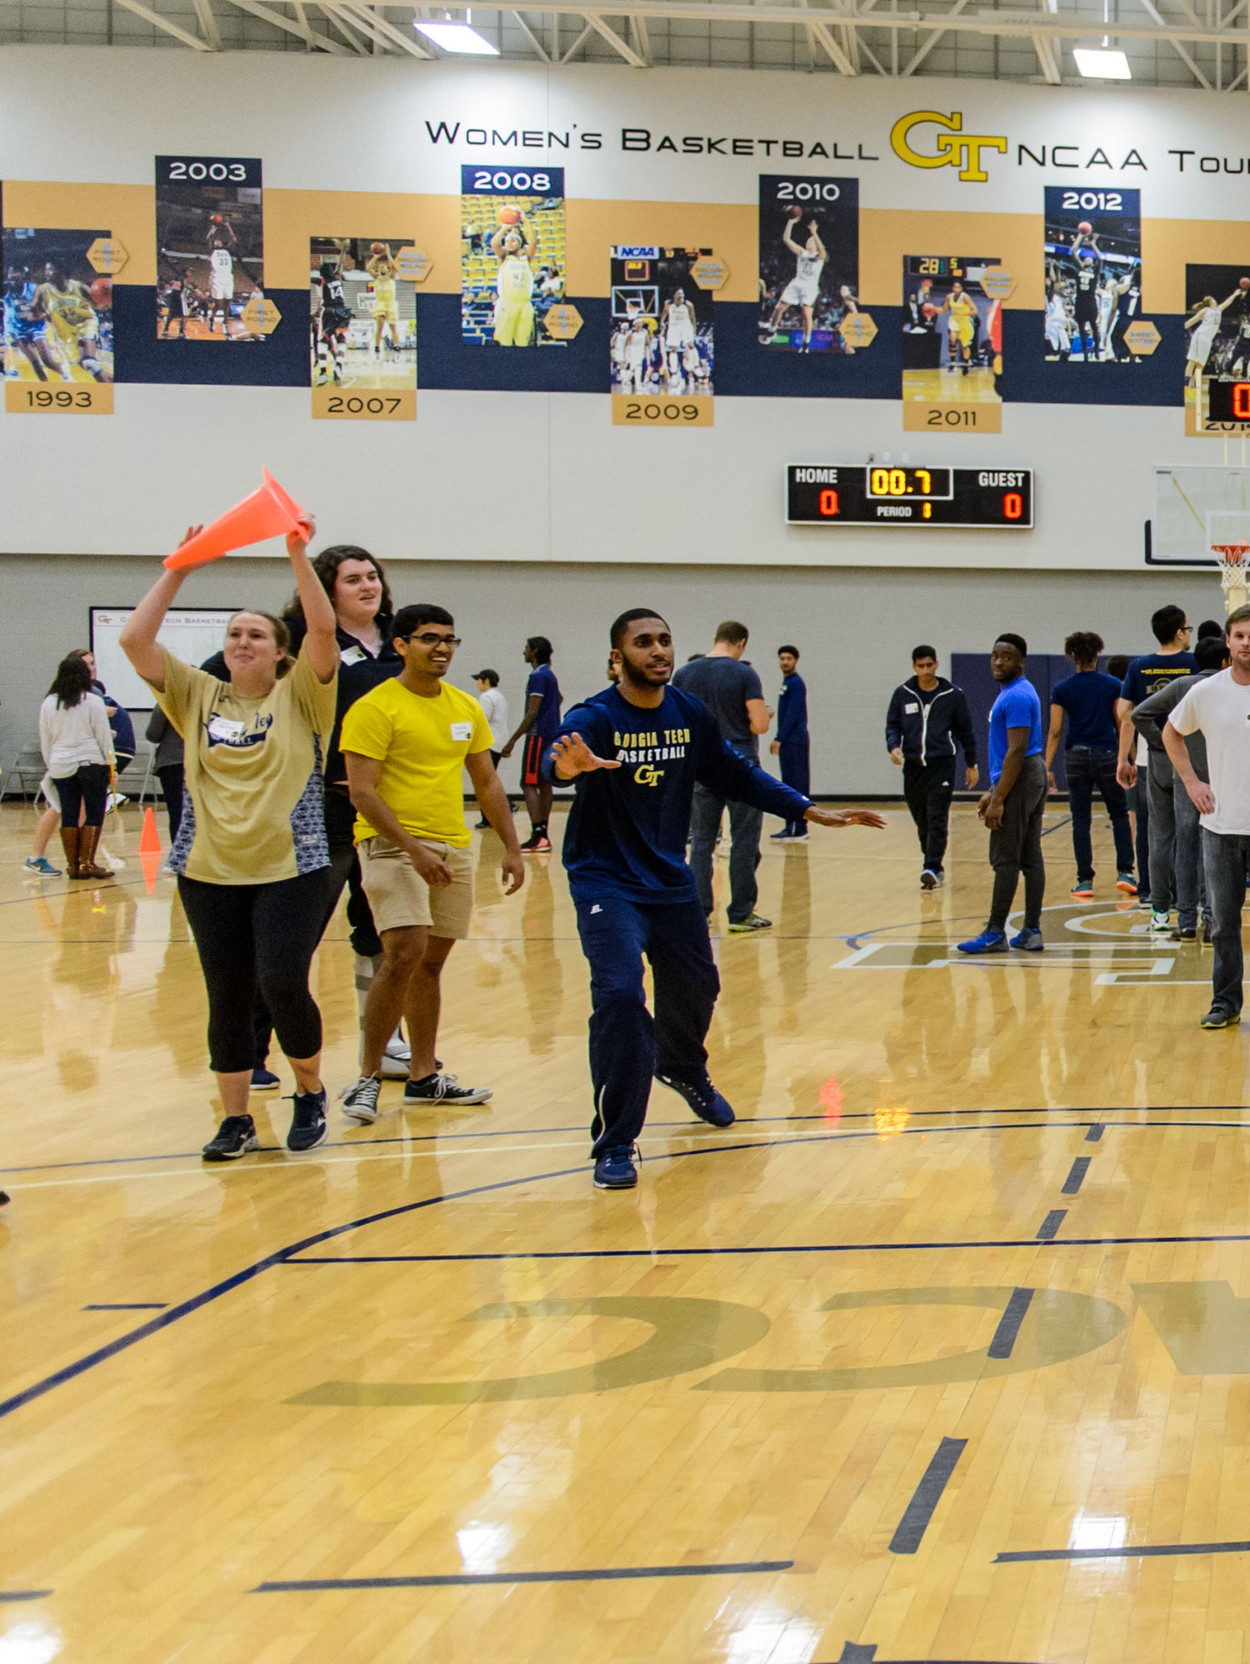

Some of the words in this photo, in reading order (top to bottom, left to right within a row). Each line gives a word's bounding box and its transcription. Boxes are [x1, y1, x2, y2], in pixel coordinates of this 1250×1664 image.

[425, 121, 602, 150] WOMEN'S
[621, 128, 879, 161] BASKETBALL
[890, 110, 1007, 182] GT
[1017, 144, 1148, 171] NCAA
[169, 162, 247, 181] 2003
[474, 171, 551, 190] 2008
[776, 182, 840, 201] 2010
[1062, 192, 1123, 211] 2012
[621, 247, 656, 257] NCAA
[27, 391, 92, 408] 1993
[328, 397, 402, 414] 2007
[625, 404, 699, 421] 2009
[927, 410, 977, 426] 2011
[796, 468, 838, 484] HOME
[978, 472, 1025, 487] GUEST
[819, 489, 838, 515] 0
[1004, 493, 1022, 519] 0
[876, 506, 912, 517] PERIOD
[614, 731, 658, 748] GORGIA
[663, 728, 691, 745] TECH
[616, 745, 685, 763] BASKETBALL
[633, 764, 665, 787] GT
